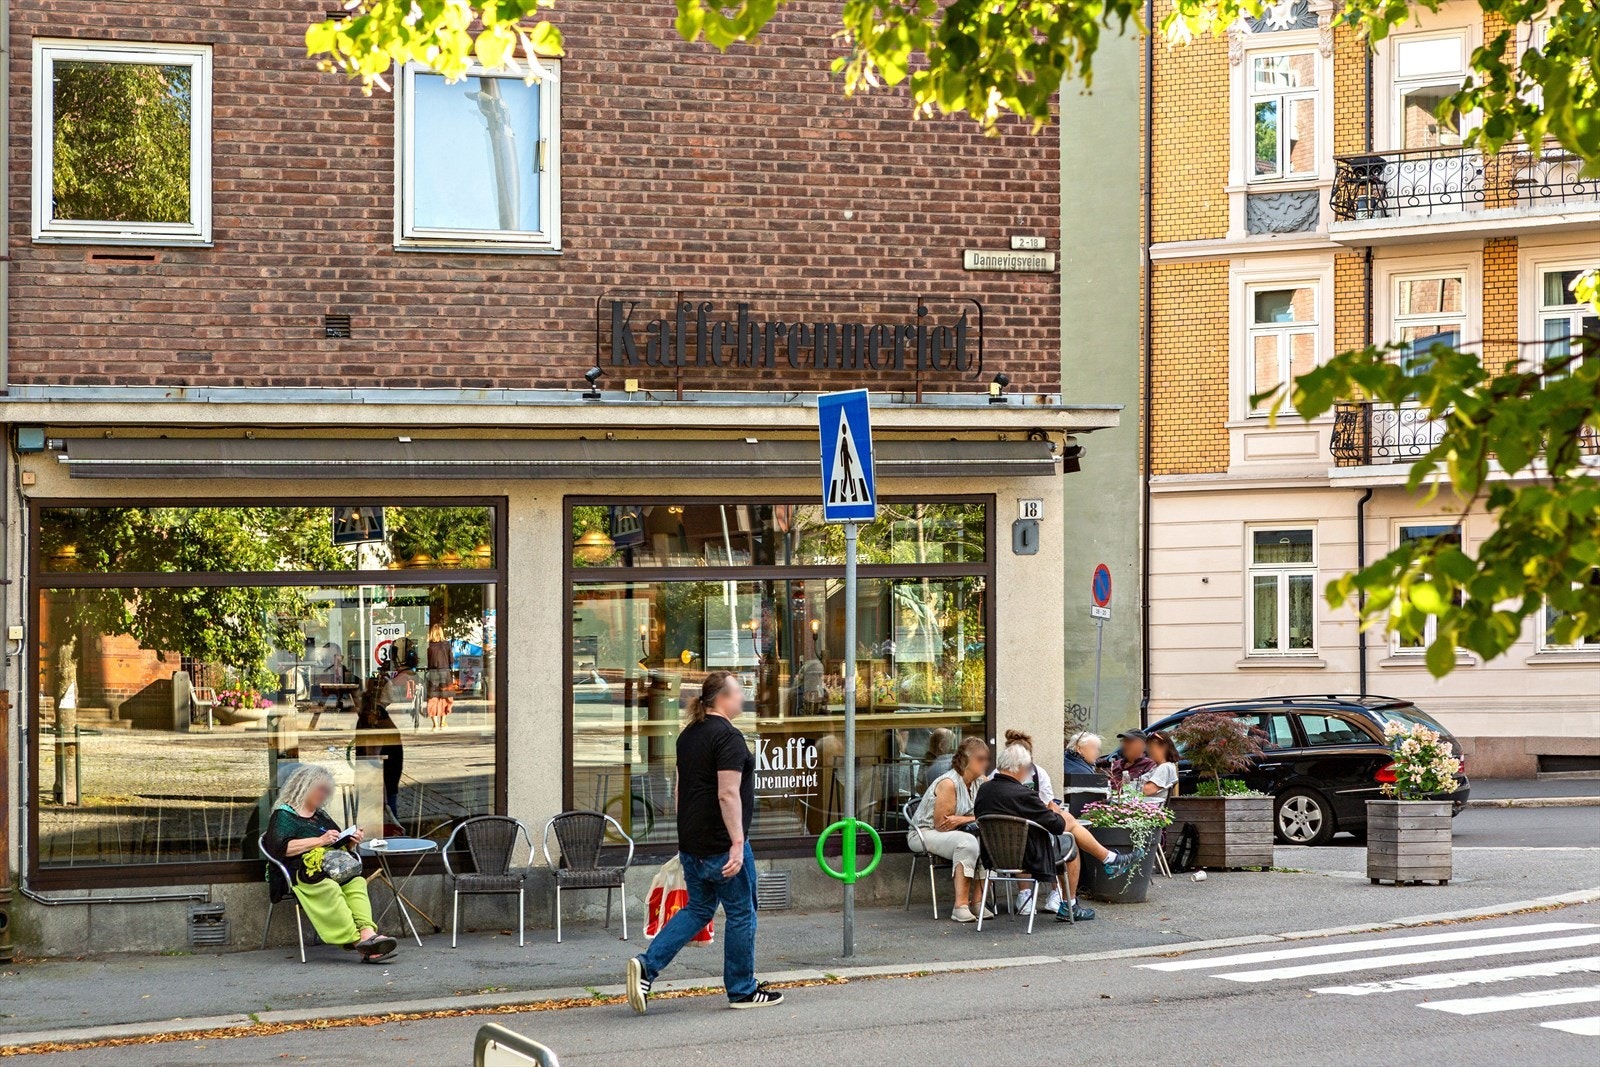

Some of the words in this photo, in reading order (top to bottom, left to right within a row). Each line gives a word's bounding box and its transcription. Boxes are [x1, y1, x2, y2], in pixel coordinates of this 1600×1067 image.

[1019, 238, 1039, 247] 2-18
[973, 252, 1047, 270] Dannevigsveien
[609, 300, 974, 372] Kaffebrenneriet
[1024, 502, 1038, 517] 18
[376, 626, 400, 636] Sone
[754, 736, 818, 771] Kaffe
[754, 771, 818, 790] brenneriet
